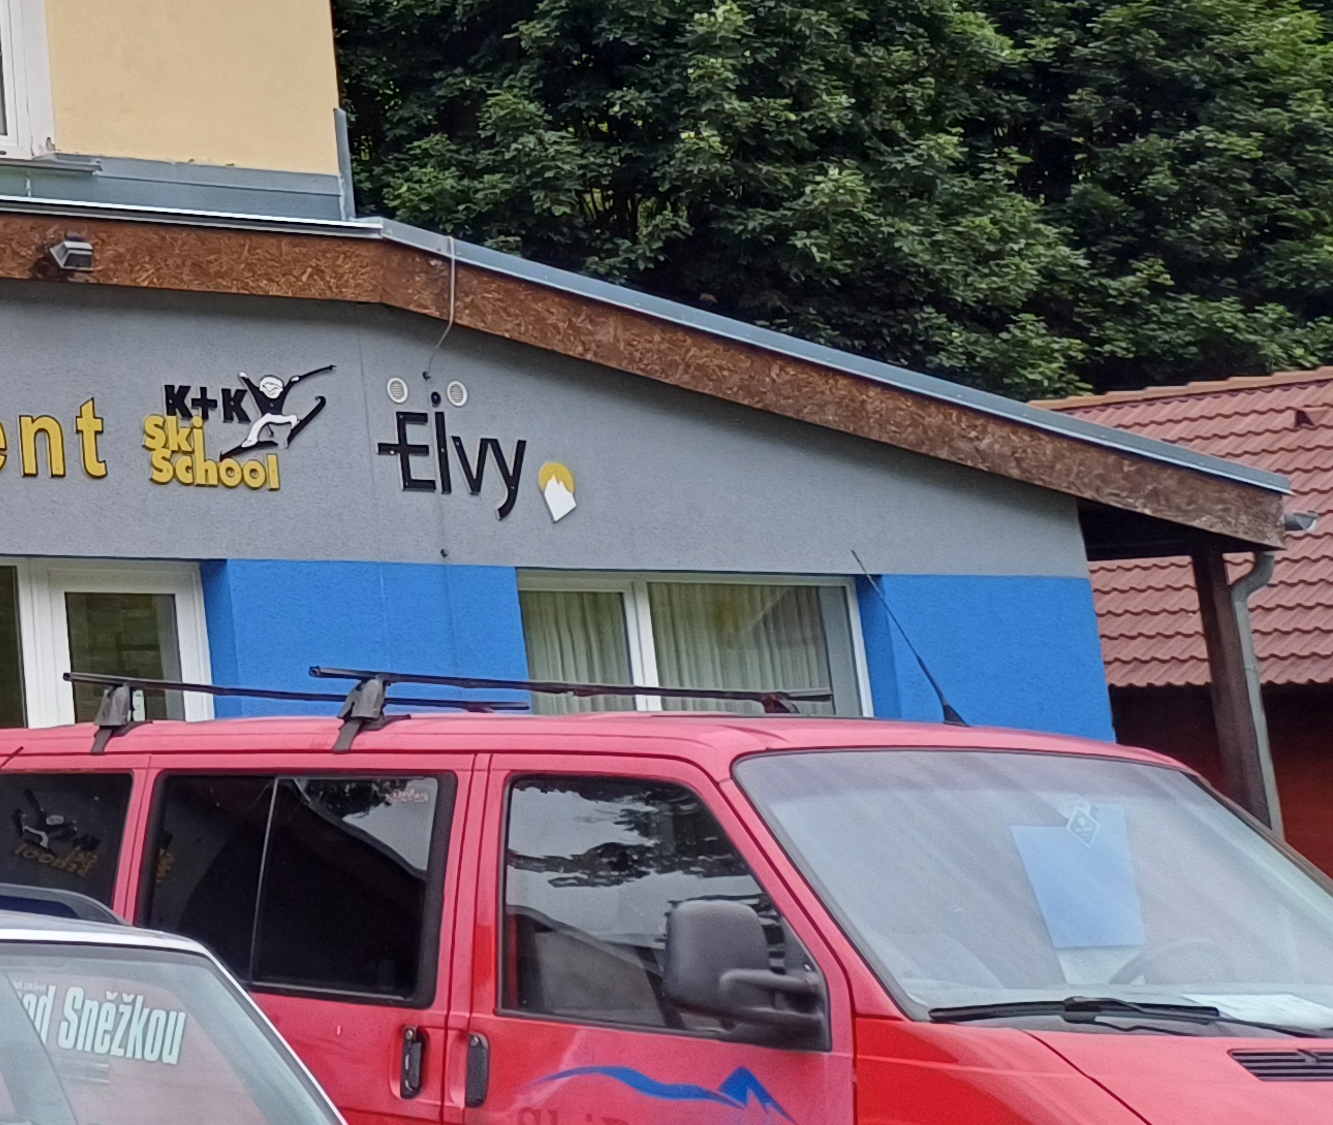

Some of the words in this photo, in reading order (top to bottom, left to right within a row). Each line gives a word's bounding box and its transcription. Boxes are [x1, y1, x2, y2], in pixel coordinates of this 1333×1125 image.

[164, 384, 251, 423] K+K
[143, 414, 205, 454] Ski
[150, 447, 282, 492] School
[58, 985, 187, 1065] Sněžkou
